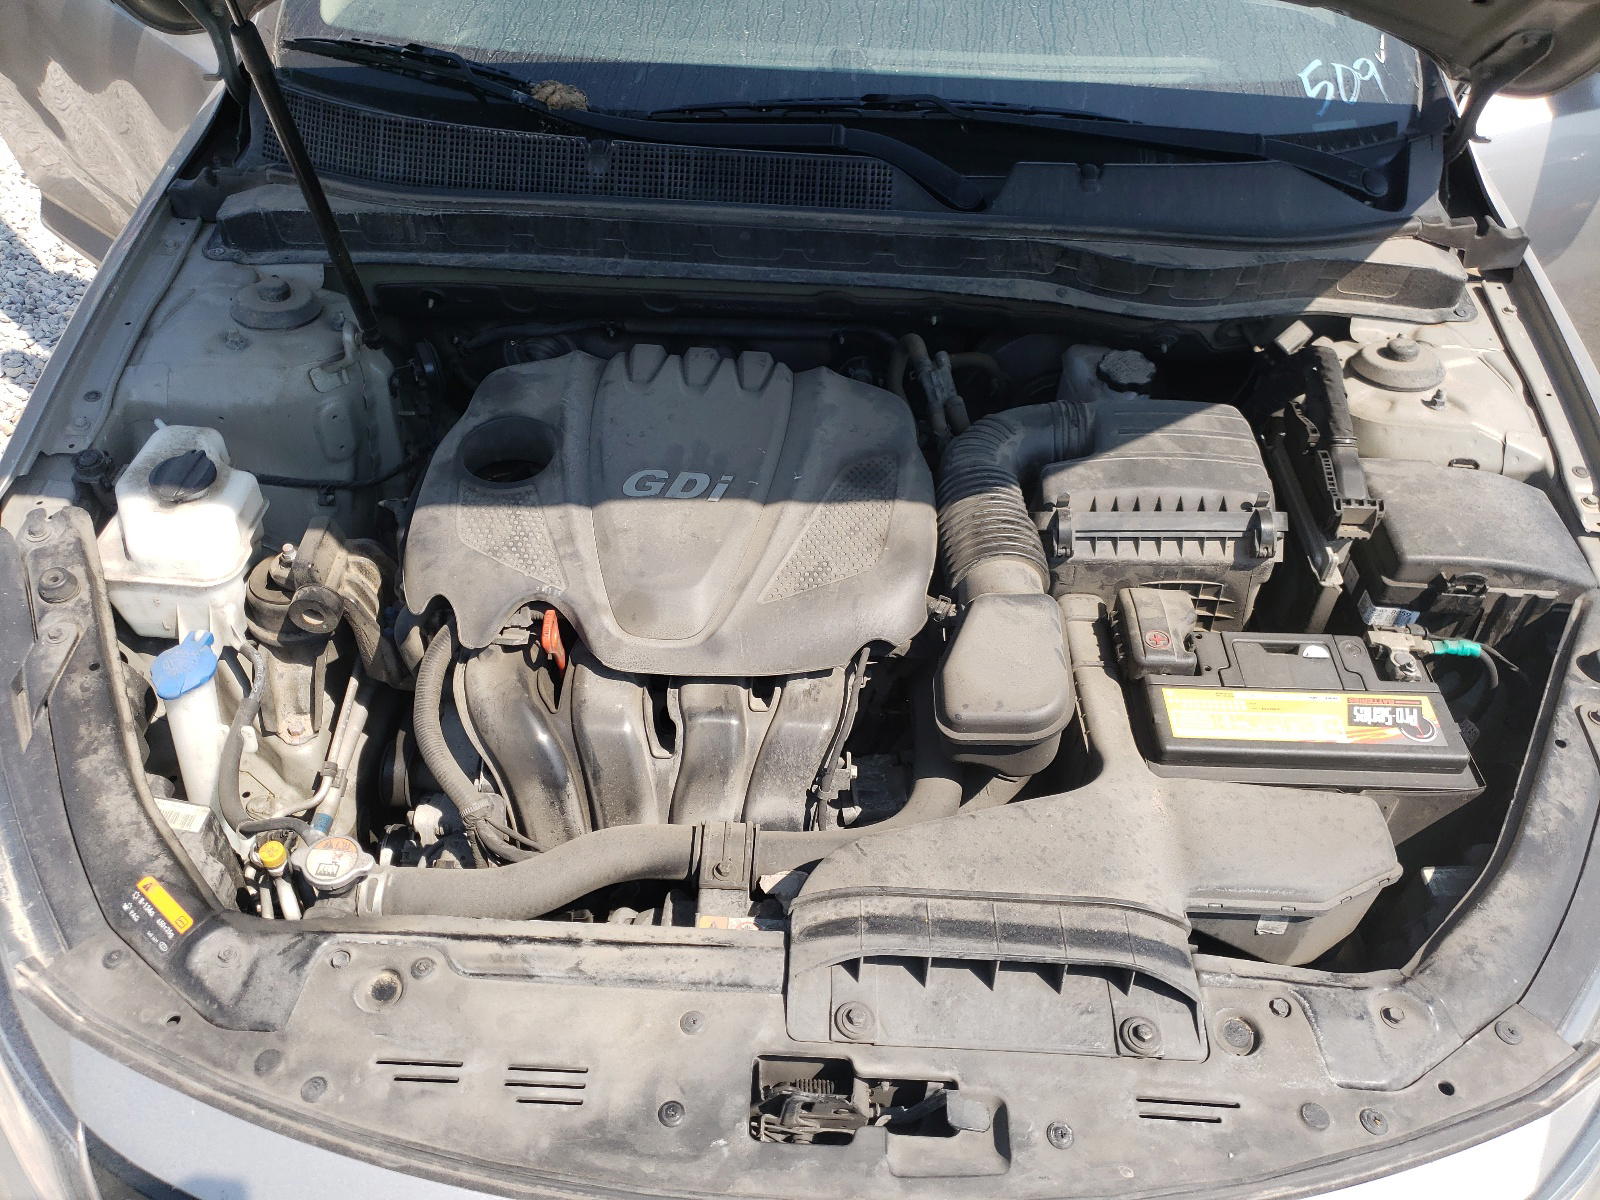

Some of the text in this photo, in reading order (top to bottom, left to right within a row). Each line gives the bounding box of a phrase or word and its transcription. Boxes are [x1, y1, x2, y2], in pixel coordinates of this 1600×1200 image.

[1297, 57, 1392, 117] 509
[622, 469, 734, 502] GDi
[1353, 706, 1418, 727] Pro-Series
